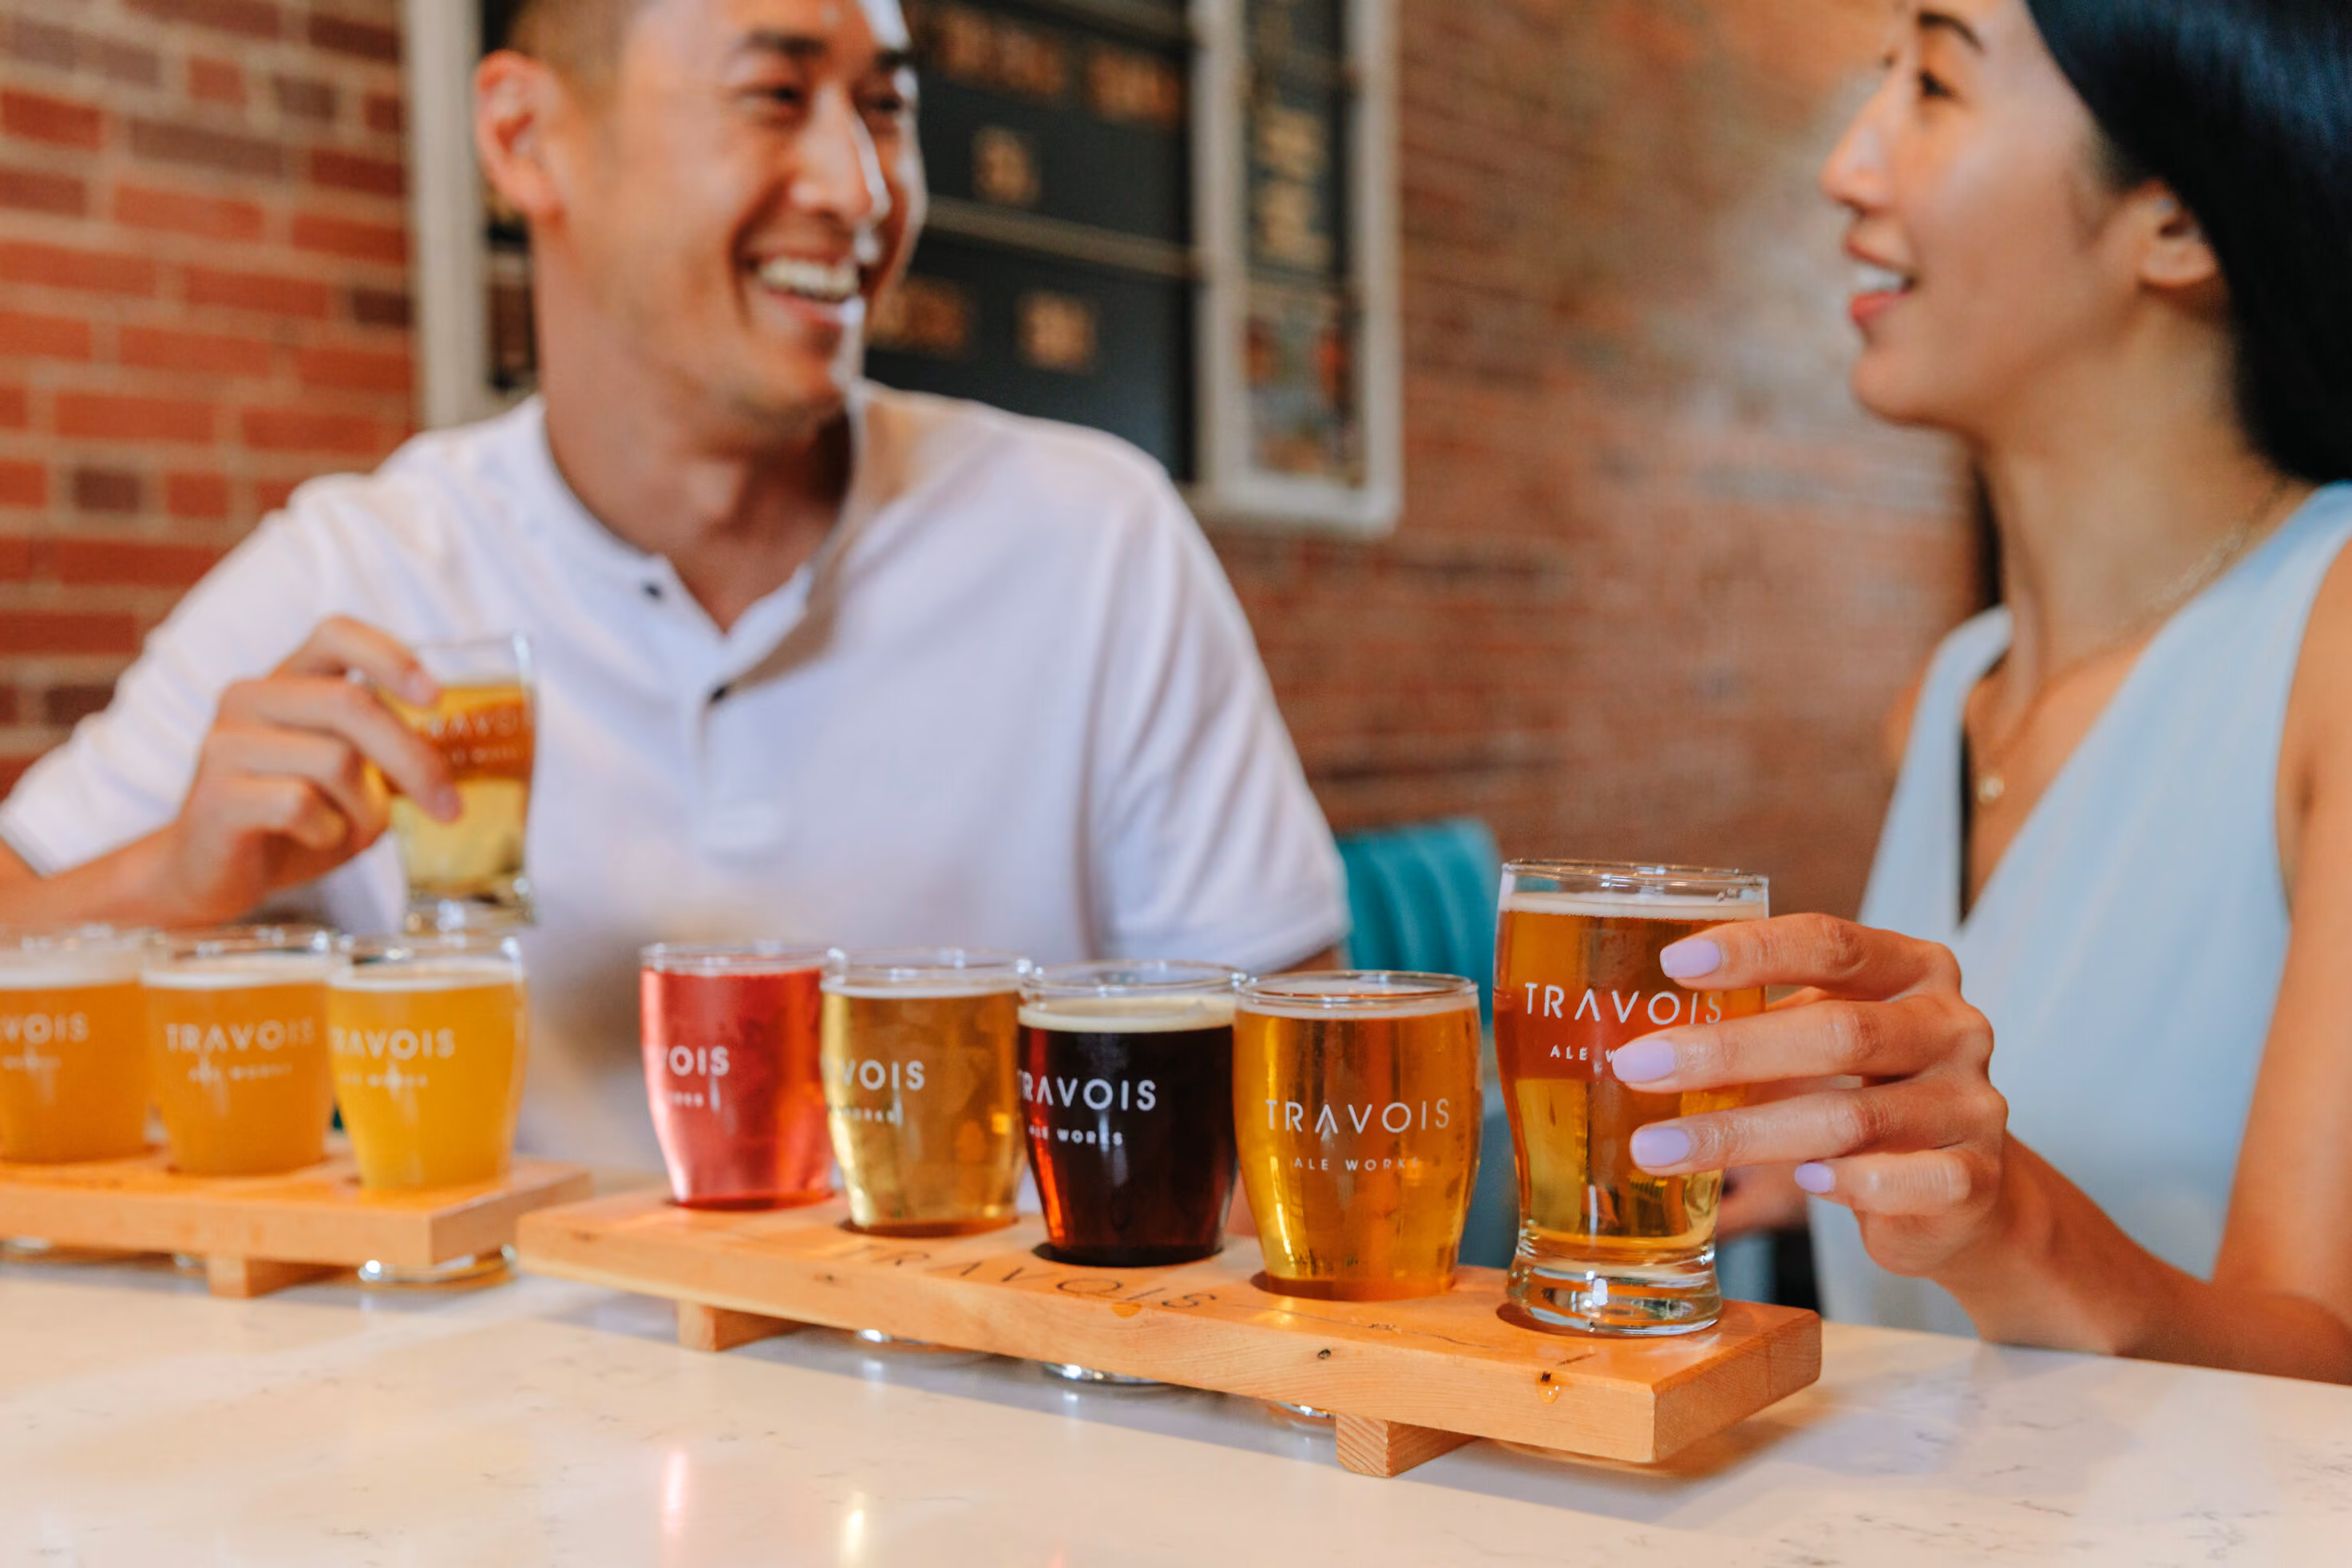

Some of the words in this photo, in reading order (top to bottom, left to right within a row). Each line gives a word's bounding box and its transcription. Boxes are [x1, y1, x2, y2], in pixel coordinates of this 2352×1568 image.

[1525, 981, 1722, 1024] TRAVOIS
[0, 1012, 89, 1045] VOIS
[1550, 1044, 1588, 1061] ALE
[836, 1059, 925, 1091] VOIS
[1265, 1098, 1449, 1134] TRAVOIS
[1294, 1157, 1328, 1170] ALE
[1345, 1156, 1419, 1171] WORKS
